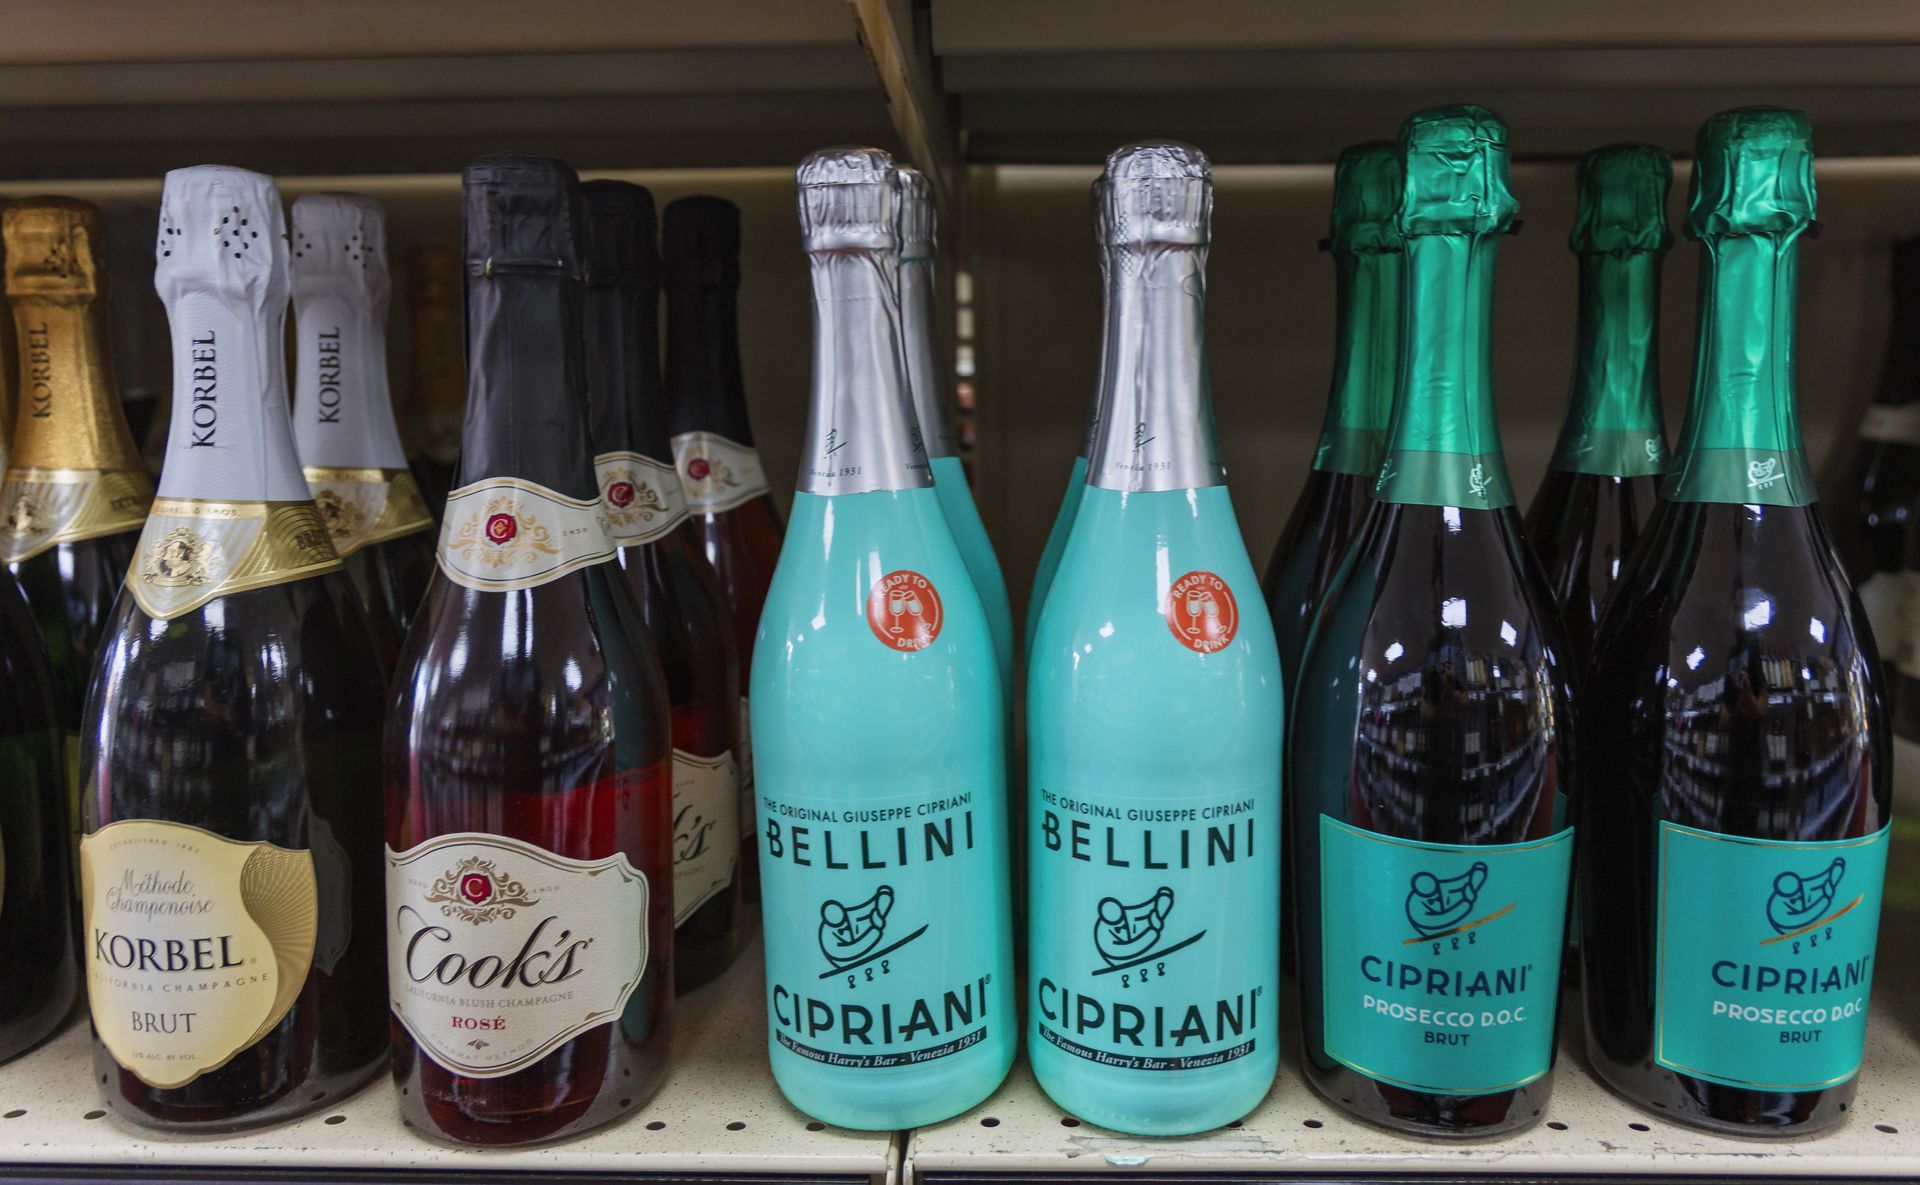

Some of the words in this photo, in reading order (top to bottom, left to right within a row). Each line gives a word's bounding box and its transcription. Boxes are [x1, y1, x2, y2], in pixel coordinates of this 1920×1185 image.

[30, 322, 50, 419] KORBEL
[318, 326, 341, 424] KORBEL
[191, 330, 216, 450] KORBEL
[839, 466, 862, 477] 1931
[1148, 461, 1172, 471] 1931
[912, 575, 927, 589] TO
[1173, 574, 1207, 599] READY
[1209, 576, 1223, 590] TO
[1193, 633, 1230, 652] DRINK
[764, 797, 777, 813] THE
[779, 804, 838, 823] ORIGINAL
[843, 806, 912, 823] GIUSEPPE
[917, 791, 972, 817] CIPRIANI
[1041, 789, 1057, 806] THE
[1060, 798, 1122, 820] ORIGINAL
[1127, 808, 1196, 822] GIUSEPPE
[1202, 798, 1255, 820] CIPRIANI
[766, 810, 974, 870] BELLINI
[1042, 809, 1254, 869] BELLINI
[106, 886, 216, 922] Champenoise
[94, 927, 244, 972] KORBEL
[397, 905, 596, 990] Cook's
[162, 973, 269, 993] CHAMPAGNE
[404, 982, 456, 1006] CALIFORNIA
[459, 997, 495, 1009] BLUSH
[497, 991, 574, 1009] CHAMPAGNE
[131, 1010, 197, 1034] BRUT
[451, 1015, 507, 1031] ROSÉ
[1363, 995, 1475, 1028] PROSECCO
[1712, 1000, 1826, 1025] PROSECCO
[778, 1033, 791, 1048] The
[791, 1040, 825, 1062] Famous
[828, 1052, 870, 1069] Harry's
[873, 1054, 898, 1066] Bar
[910, 1044, 954, 1063] Venezia
[957, 1031, 982, 1051] 1931
[1042, 1027, 1056, 1043] The
[1056, 1035, 1093, 1059] Famous
[1095, 1051, 1140, 1069] Harry's
[1143, 1057, 1167, 1070] Bar
[1180, 1052, 1224, 1069] Venezia
[1227, 1044, 1250, 1061] 1931
[1424, 1030, 1470, 1046] BRUT
[1779, 1030, 1822, 1043] BRUT
